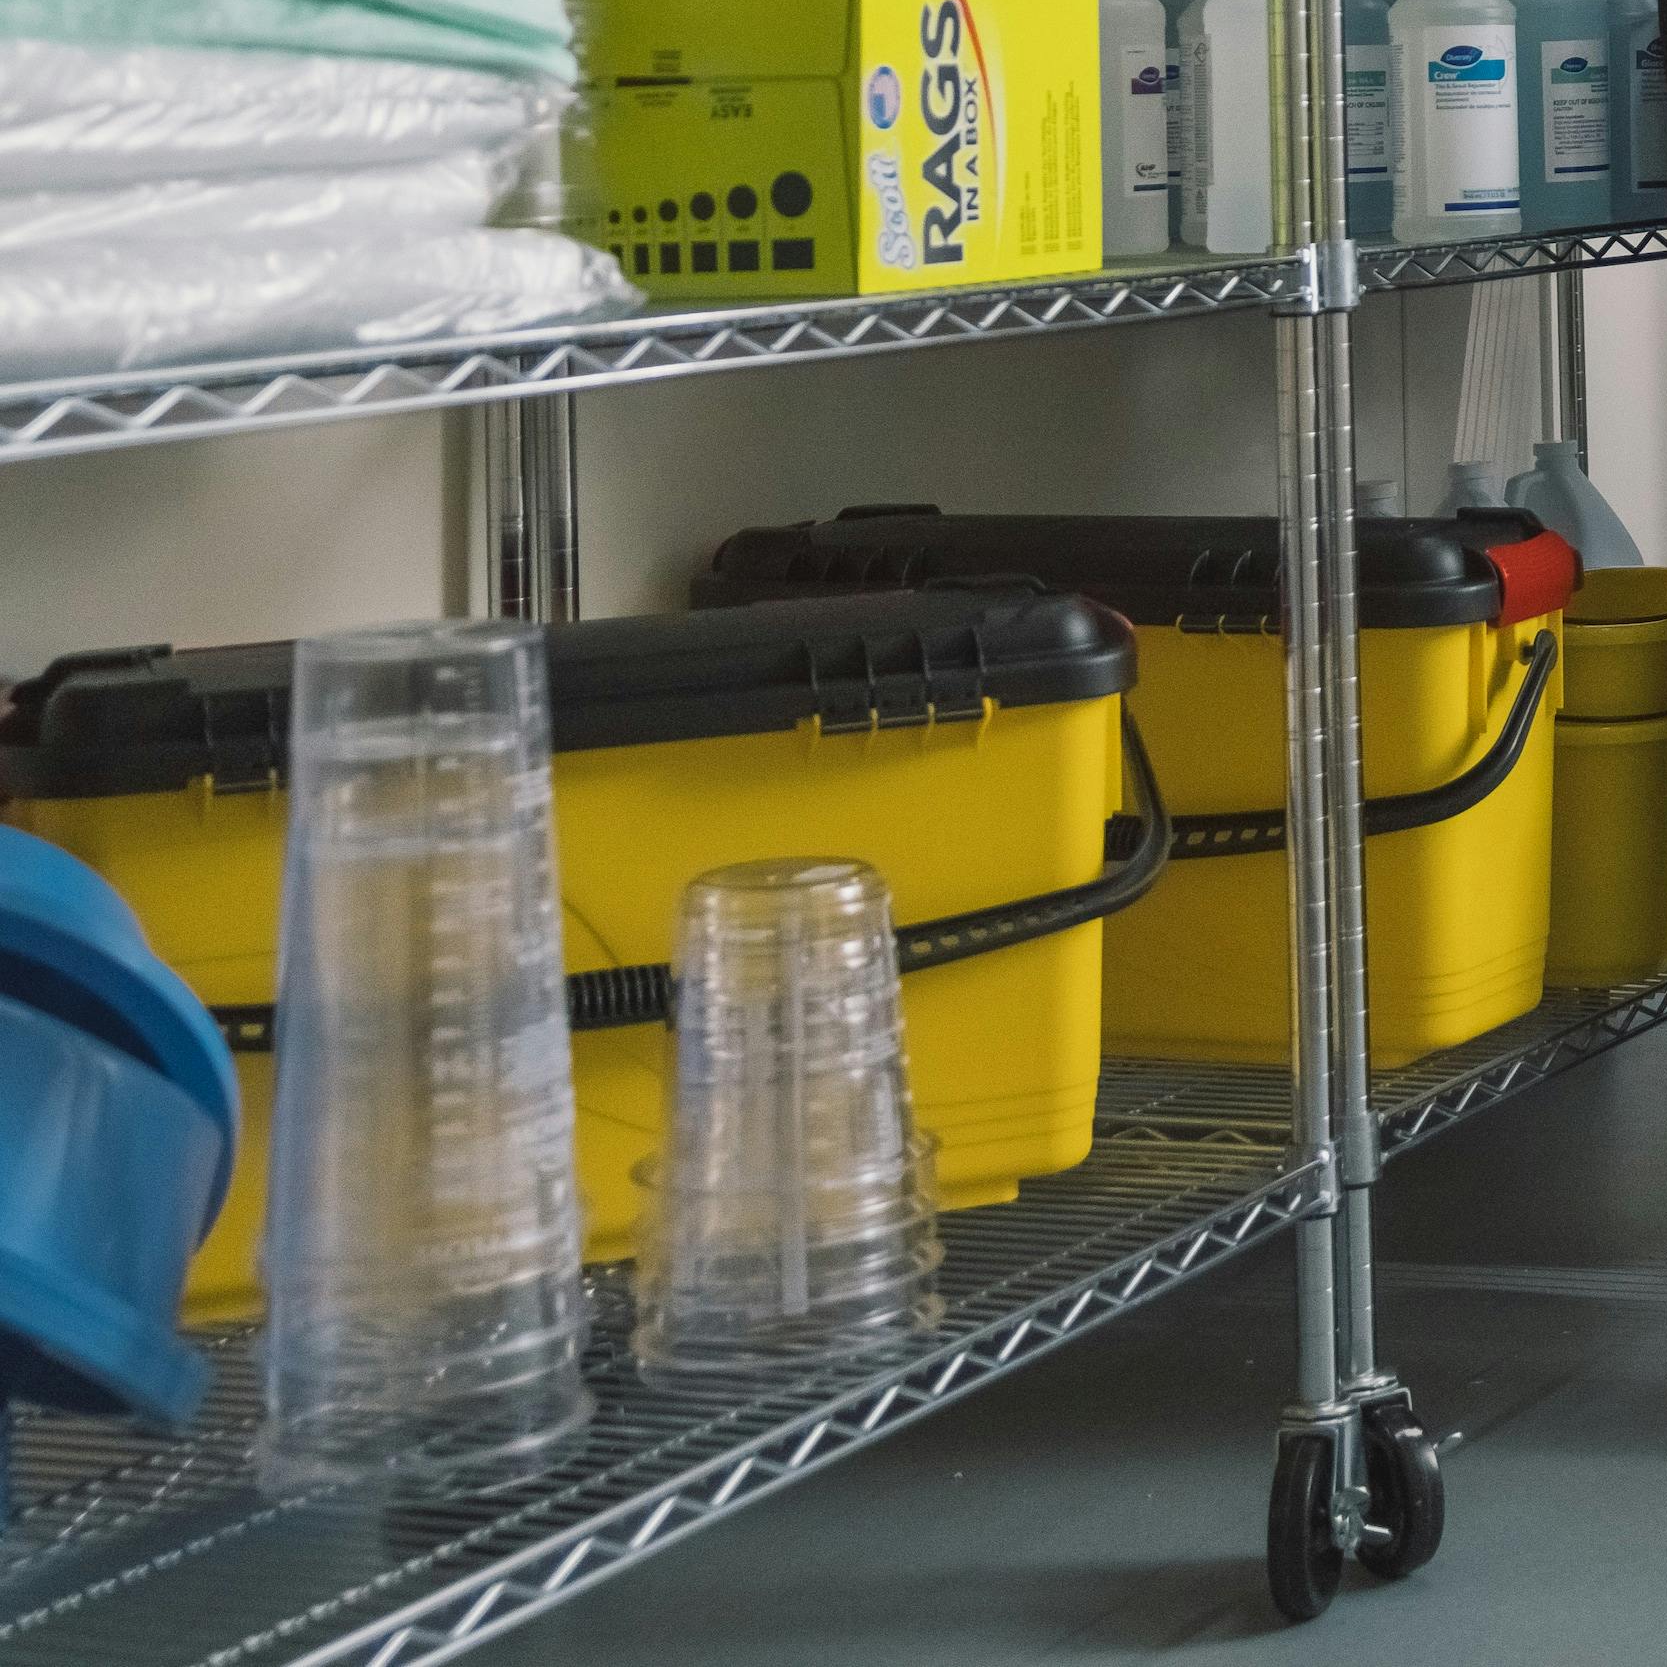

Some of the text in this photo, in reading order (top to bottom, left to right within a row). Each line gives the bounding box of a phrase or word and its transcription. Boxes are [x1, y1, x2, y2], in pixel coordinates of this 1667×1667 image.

[1434, 71, 1459, 80] Crew
[963, 77, 979, 221] IN A BOX
[868, 152, 916, 269] Scott
